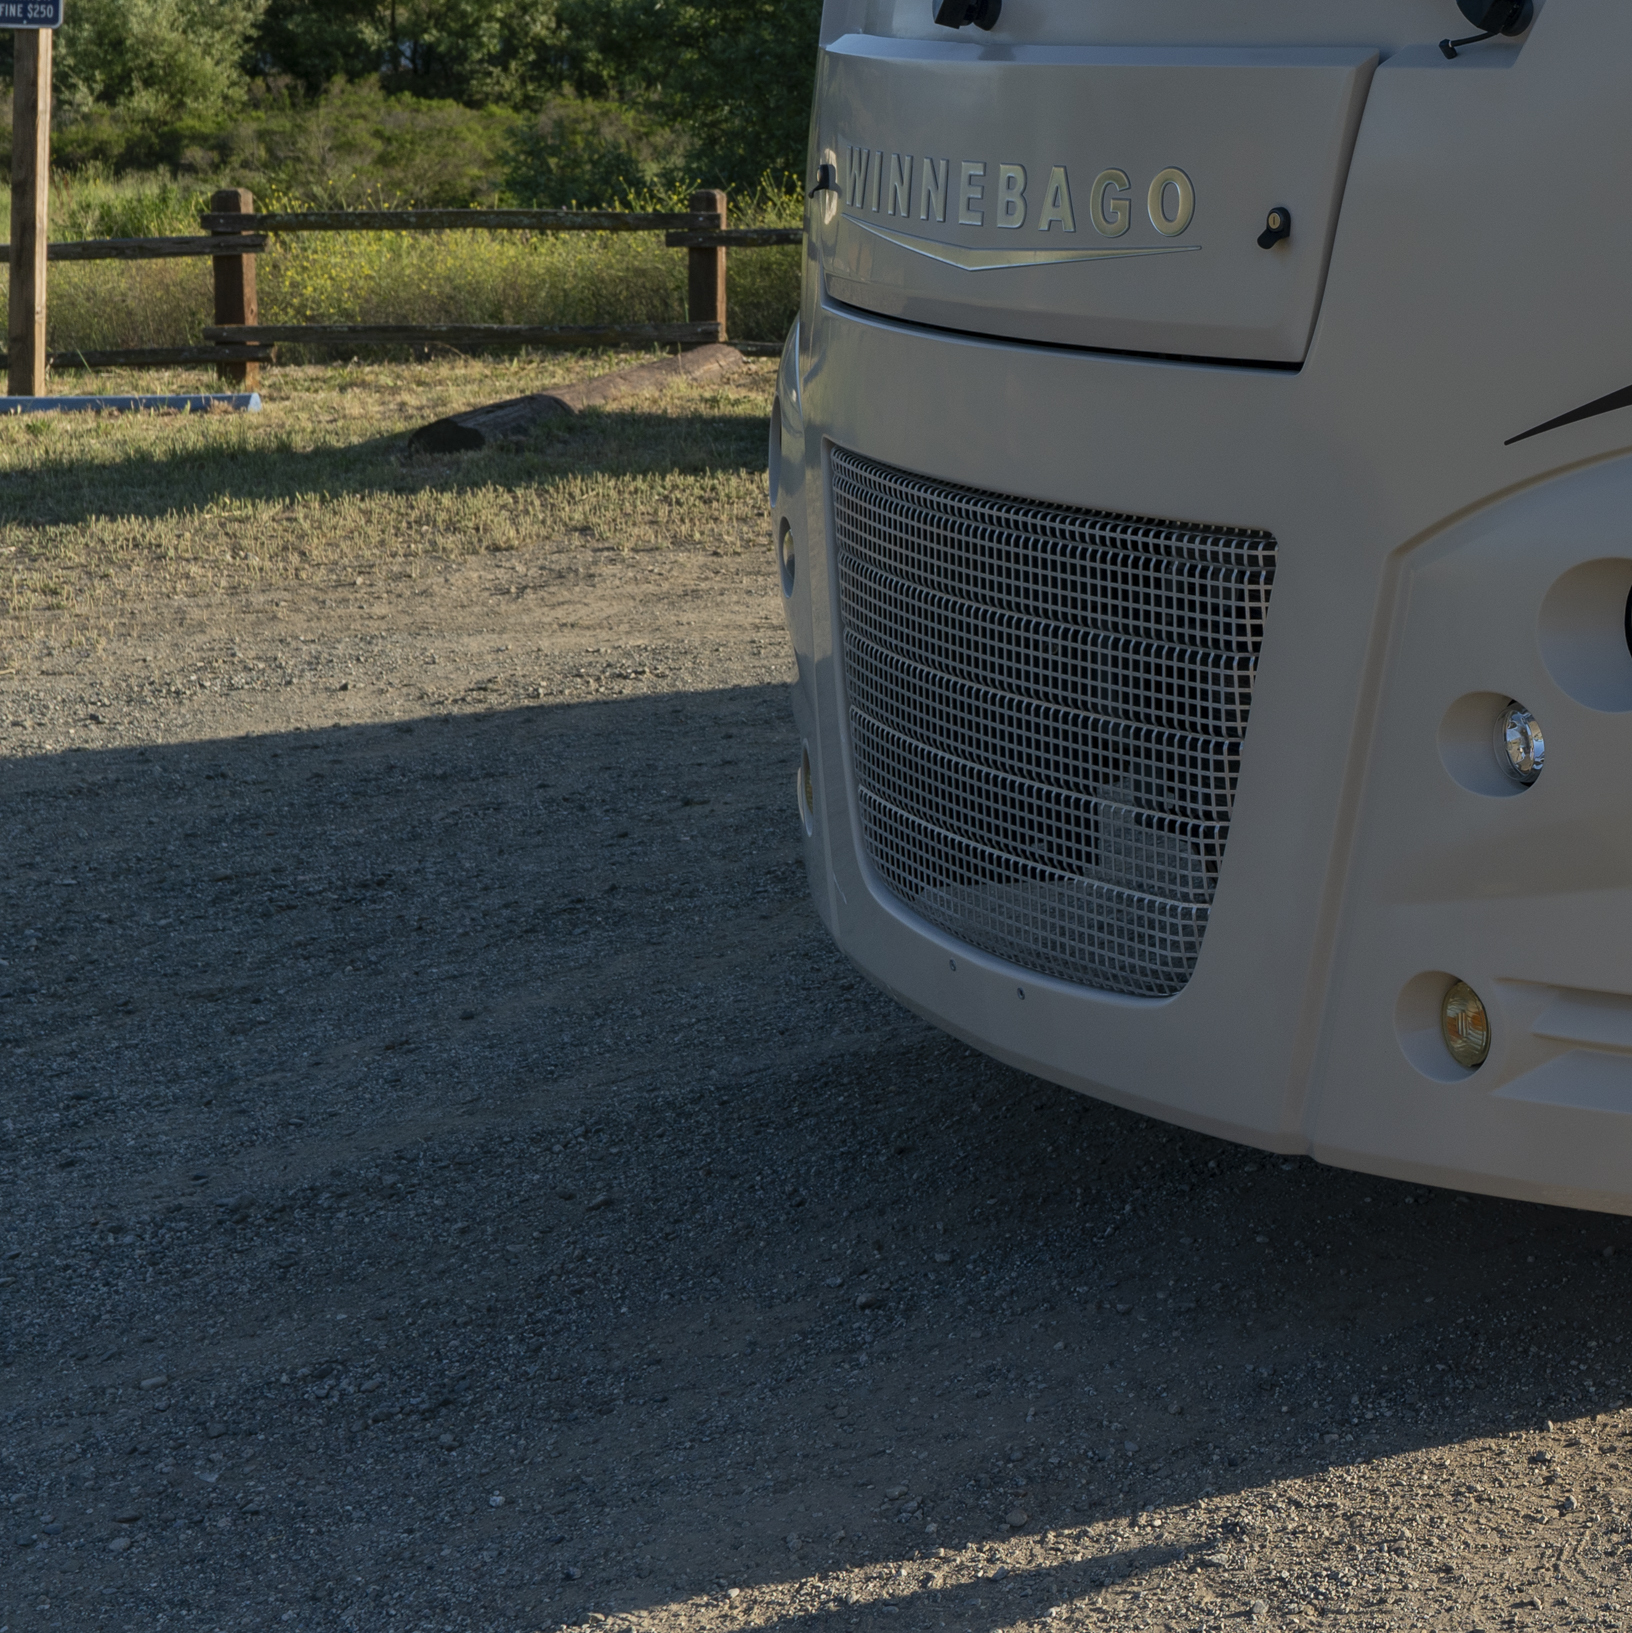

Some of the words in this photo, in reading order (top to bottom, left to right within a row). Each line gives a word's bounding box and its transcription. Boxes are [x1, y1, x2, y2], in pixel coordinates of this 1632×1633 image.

[0, 3, 23, 18] FINE
[27, 3, 54, 19] $250
[844, 144, 1197, 239] WINNEBAGO
